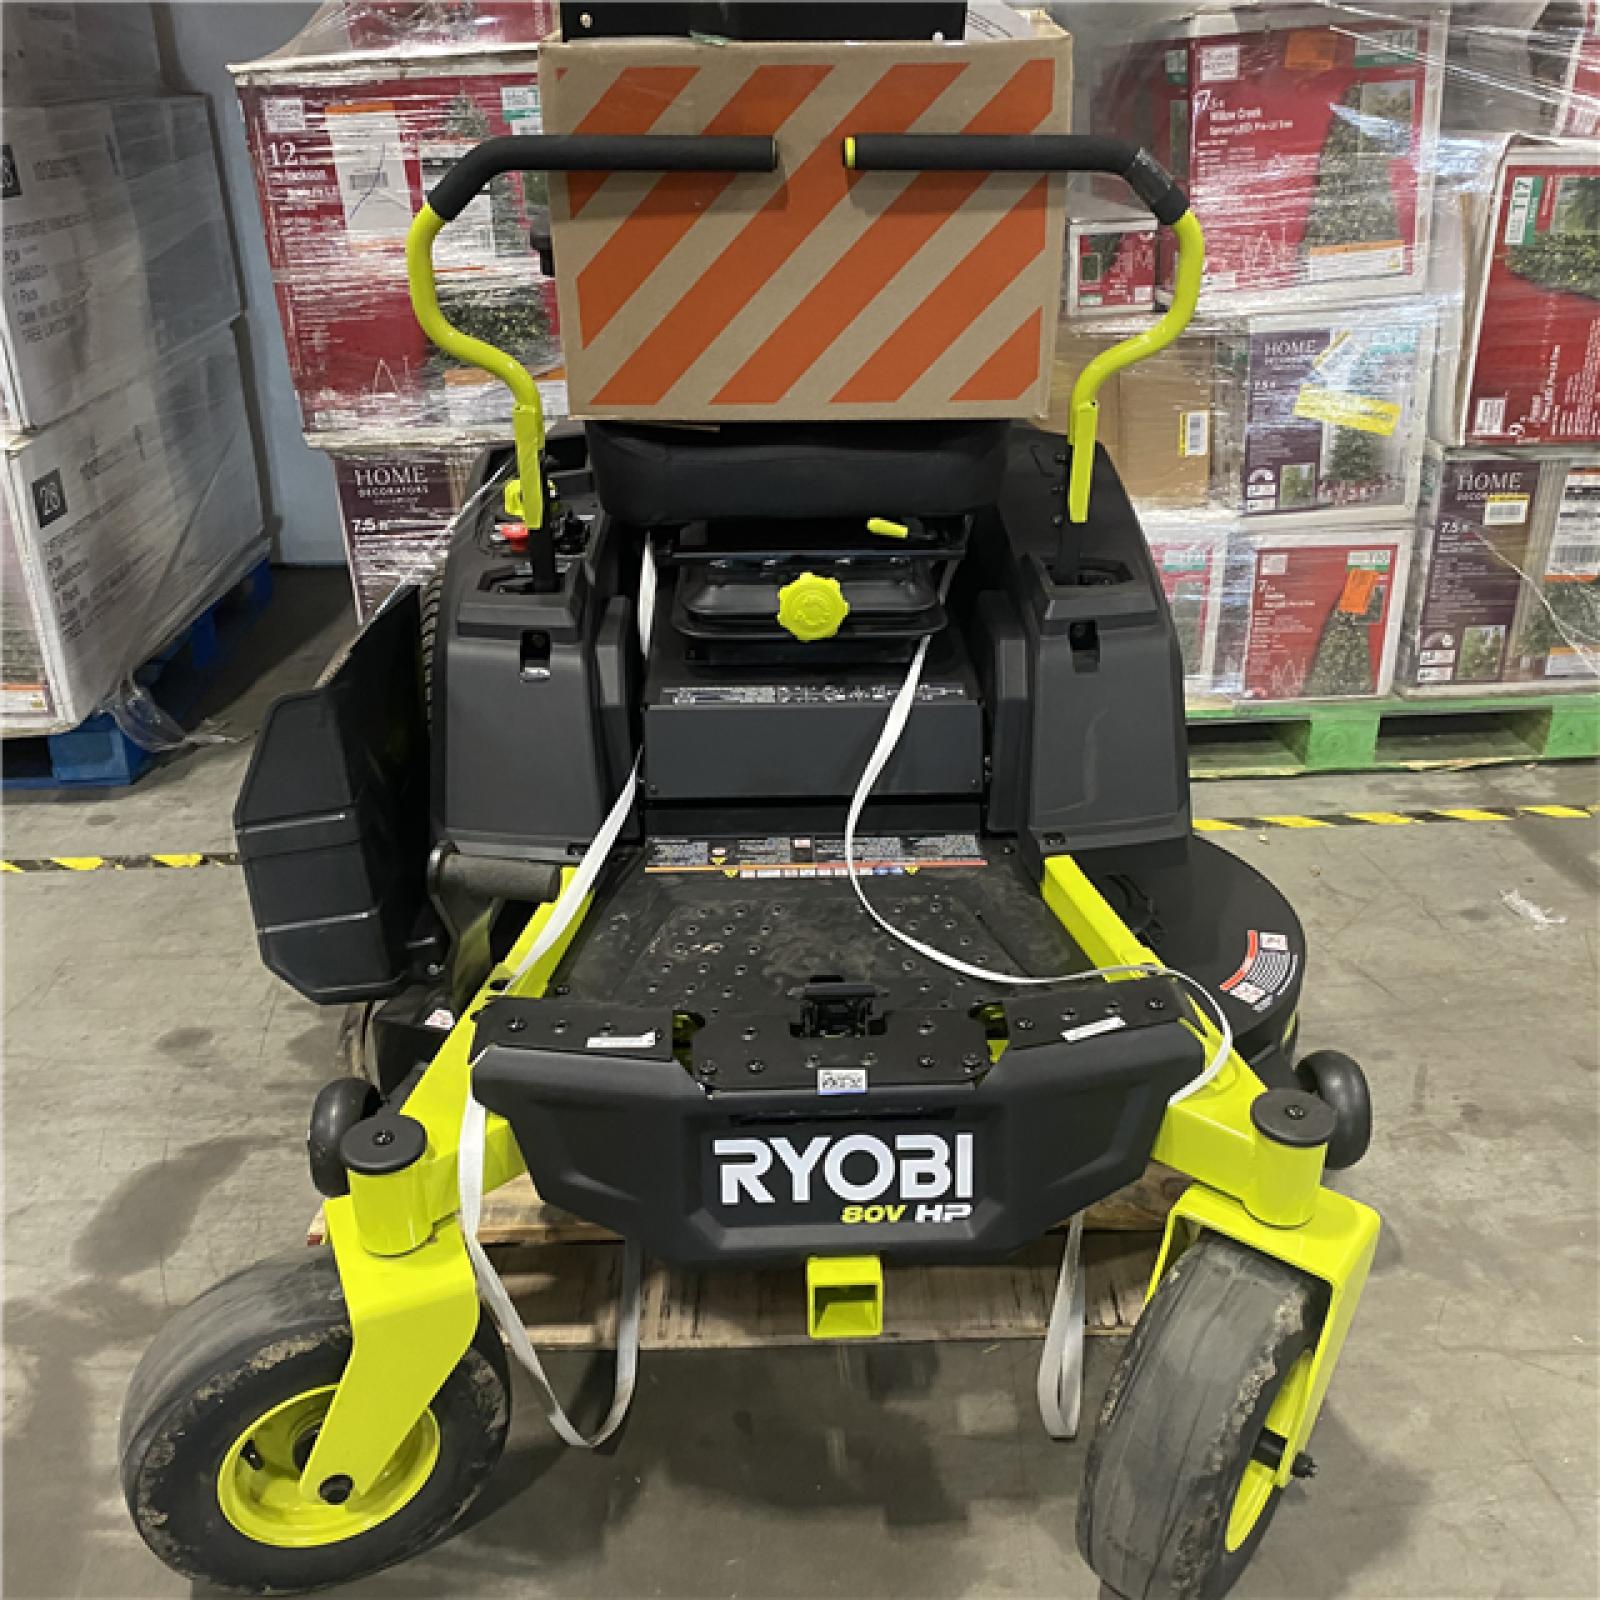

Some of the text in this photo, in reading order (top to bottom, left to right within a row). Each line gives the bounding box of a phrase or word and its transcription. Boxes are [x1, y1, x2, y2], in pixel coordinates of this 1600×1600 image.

[268, 141, 298, 166] 12
[1264, 339, 1317, 357] HOME
[354, 464, 429, 486] HOME
[1456, 471, 1523, 491] HOME
[714, 1133, 974, 1205] RYOBI
[840, 1204, 973, 1224] 80V HP
